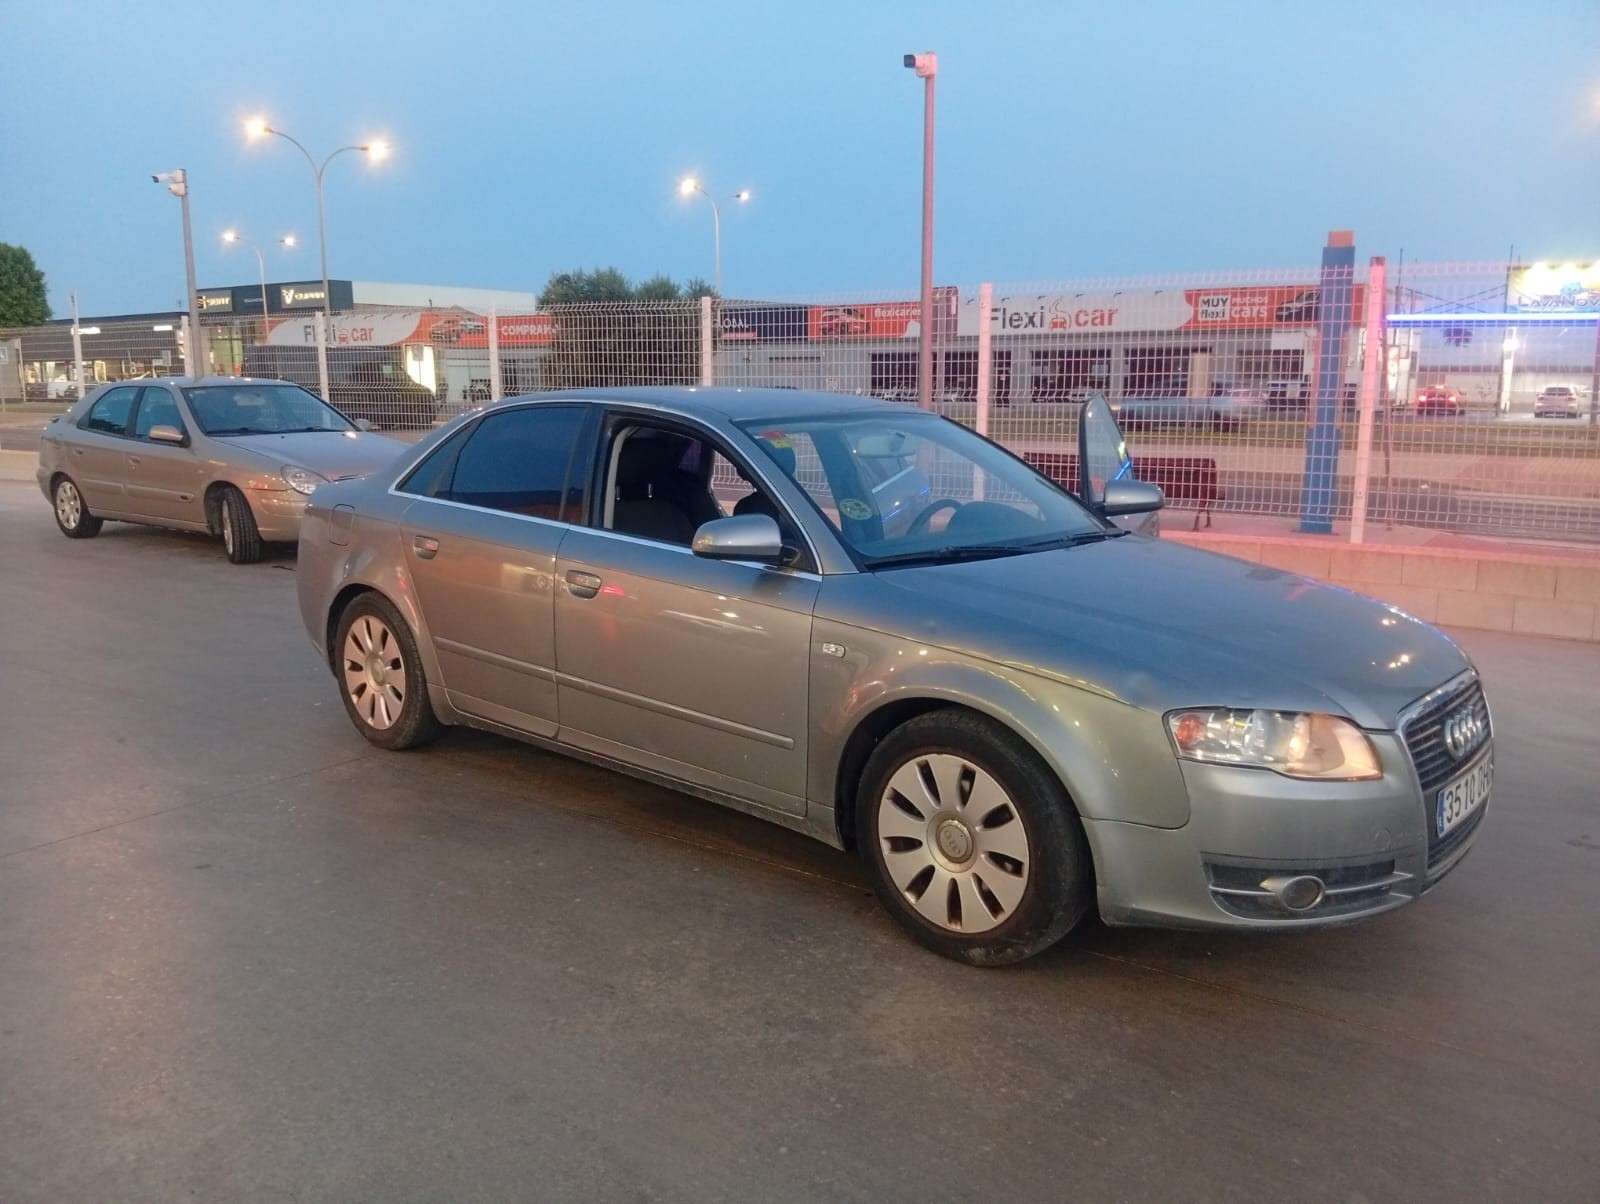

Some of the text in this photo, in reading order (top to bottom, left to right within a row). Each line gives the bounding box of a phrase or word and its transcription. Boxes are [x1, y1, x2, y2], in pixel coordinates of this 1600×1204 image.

[1202, 297, 1229, 308] MUY
[991, 305, 1118, 329] Flexi car
[351, 327, 374, 341] car
[1446, 773, 1476, 823] 3510
